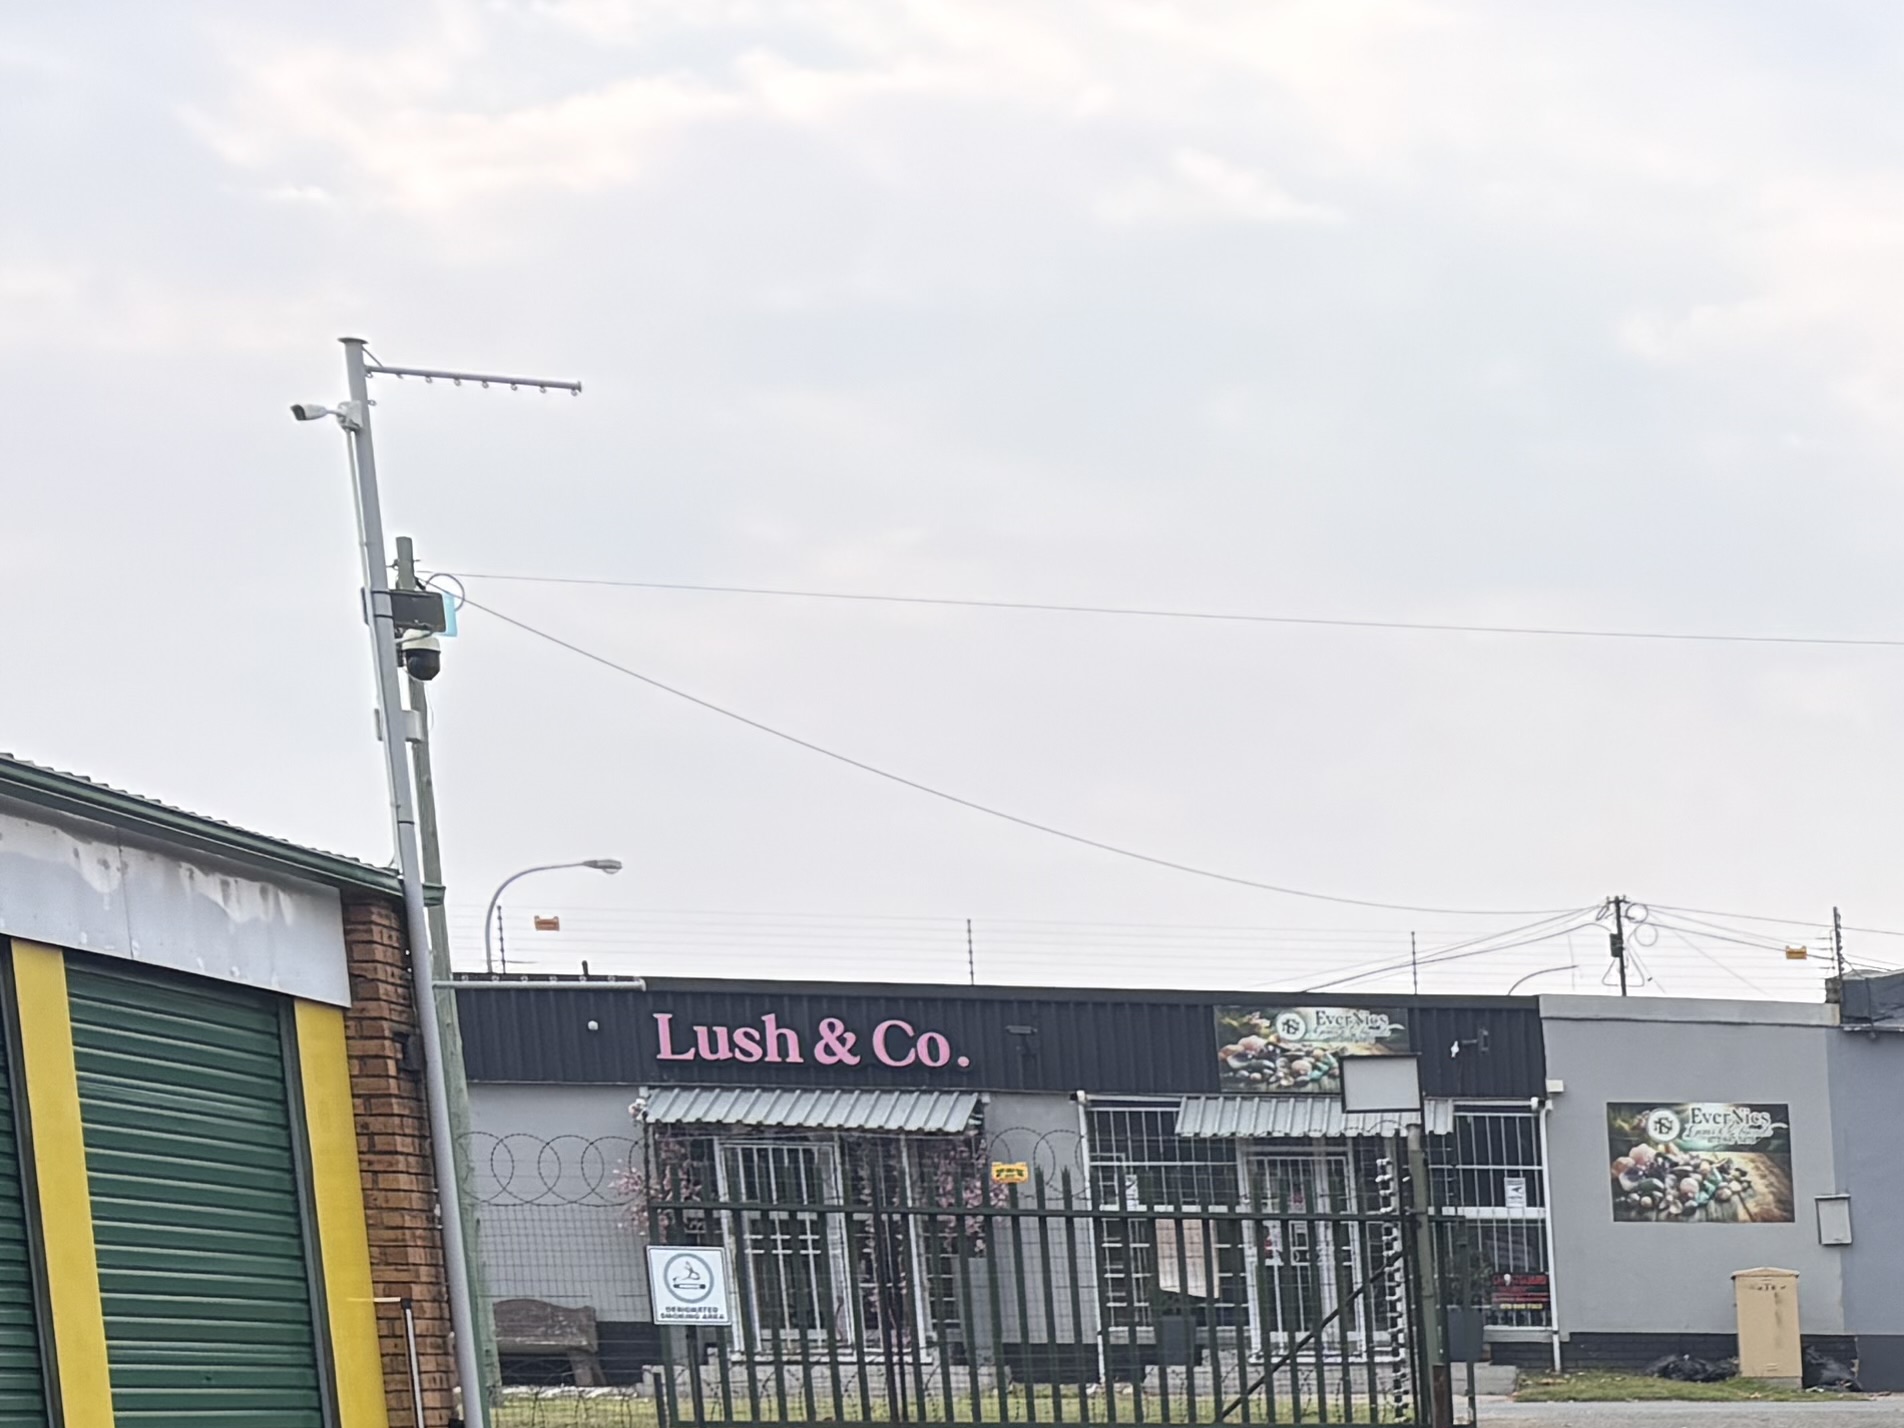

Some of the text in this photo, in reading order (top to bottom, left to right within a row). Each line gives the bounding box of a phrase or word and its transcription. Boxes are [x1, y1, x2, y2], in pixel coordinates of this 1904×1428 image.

[653, 1013, 970, 1067] Lush & Co.
